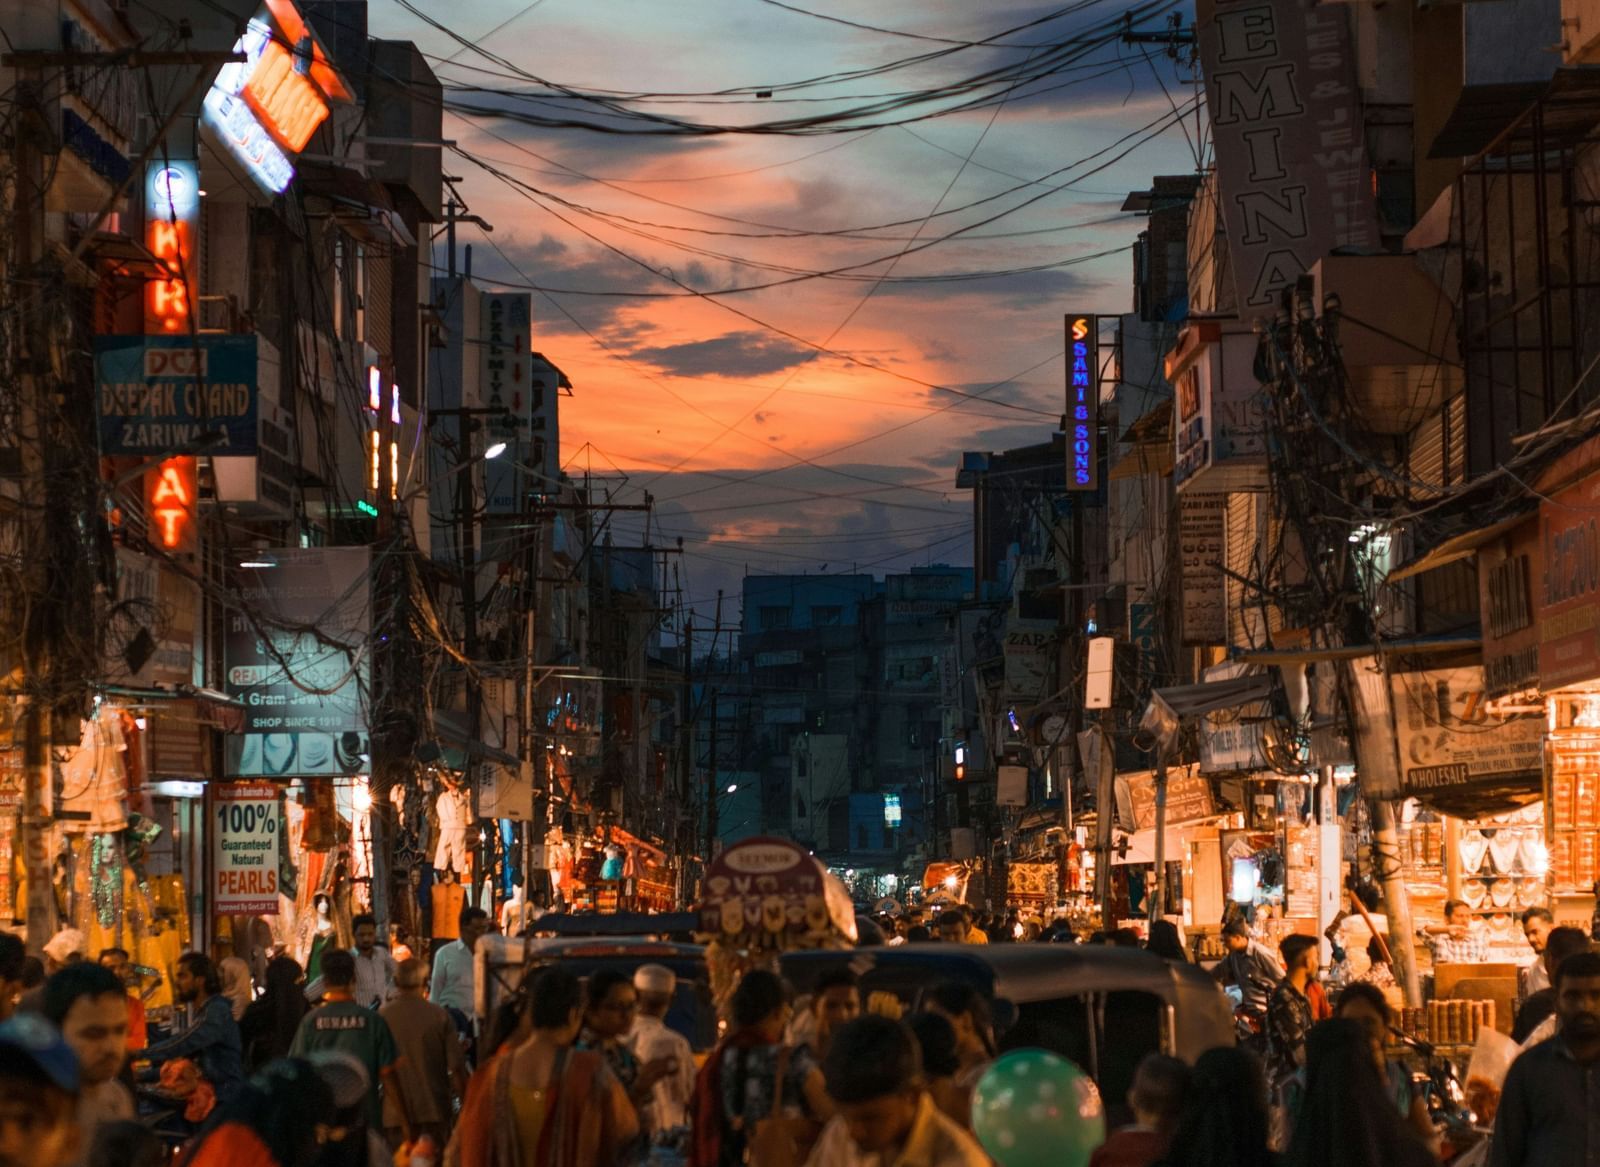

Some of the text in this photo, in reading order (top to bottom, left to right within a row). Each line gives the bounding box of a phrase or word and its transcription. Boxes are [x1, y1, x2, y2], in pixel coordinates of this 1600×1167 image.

[1213, 0, 1306, 305] EMINA
[150, 352, 205, 374] DCZ
[102, 383, 249, 416] DEEPAK CHAND
[1072, 342, 1091, 485] SAMI & SONS
[249, 693, 285, 706] Gram
[252, 717, 281, 728] SHOP
[1410, 764, 1467, 789] WHOLESALE
[218, 804, 275, 833] 100%
[221, 839, 272, 851] Guaranteed
[231, 853, 264, 865] Natural
[218, 870, 276, 895] PEARLS
